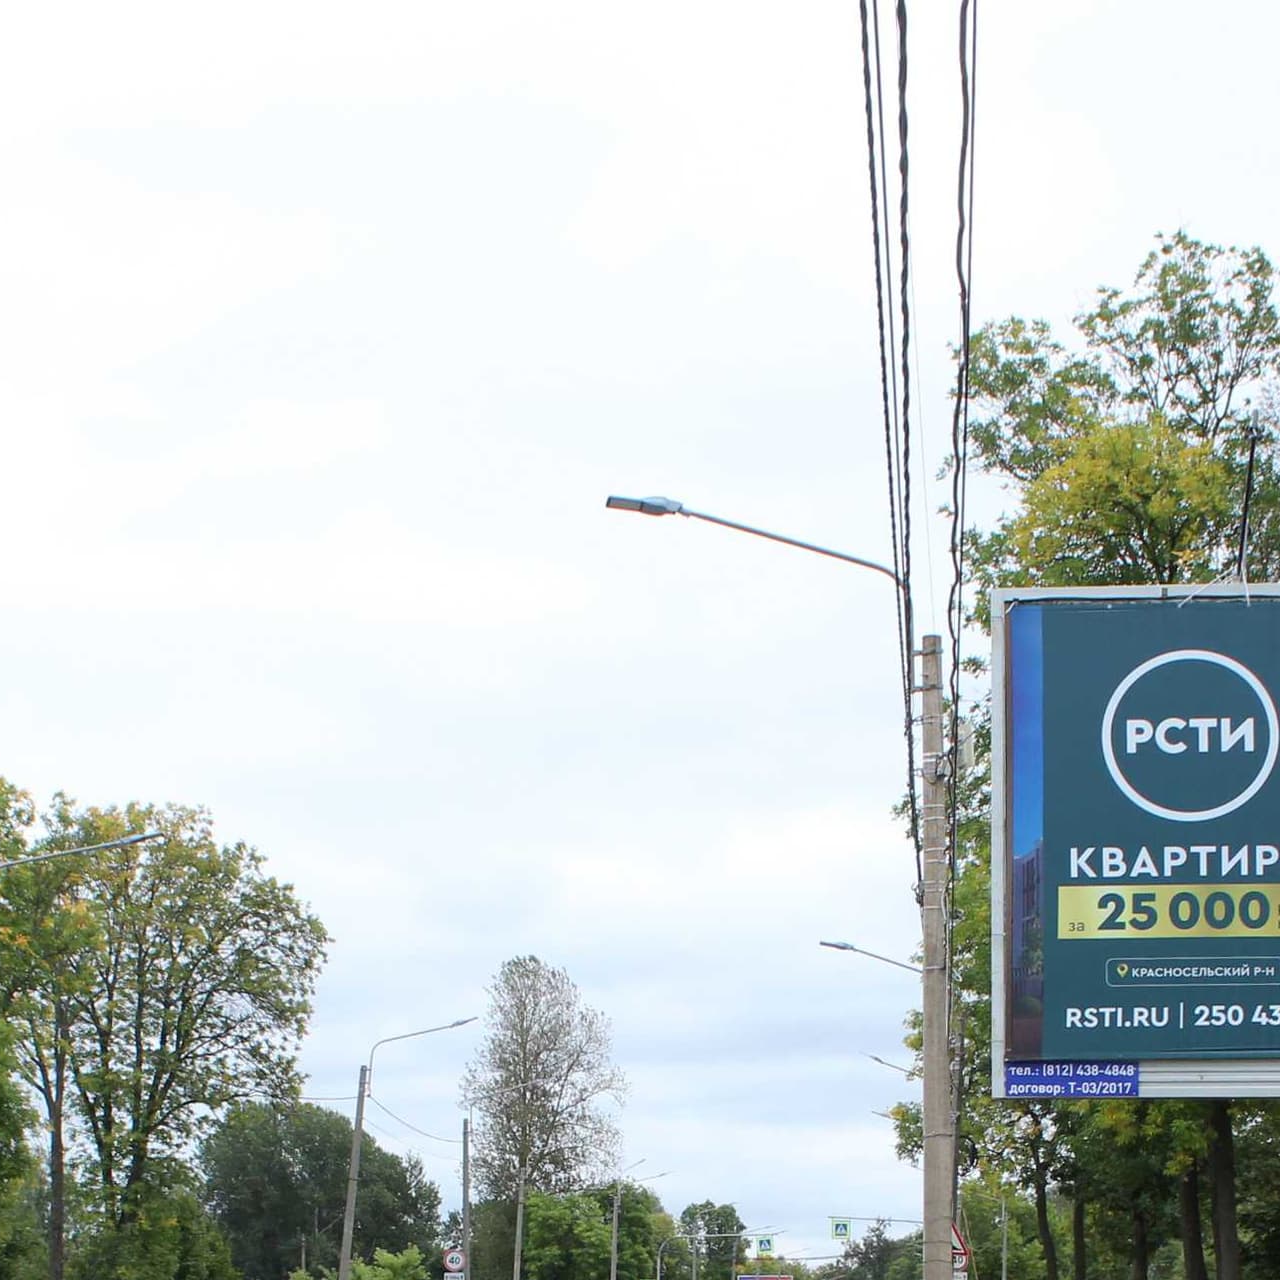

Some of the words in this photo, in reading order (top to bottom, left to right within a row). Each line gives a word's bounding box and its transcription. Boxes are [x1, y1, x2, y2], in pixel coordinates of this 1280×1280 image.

[1125, 717, 1254, 754] РСТИ
[1068, 922, 1085, 932] за
[1097, 892, 1158, 931] 25
[1169, 891, 1270, 930] 000
[1131, 964, 1250, 978] КРАСНОСЕЛЬСКИЙ
[1254, 966, 1275, 977] Р-Н
[1066, 1006, 1169, 1028] RSTI.RU
[1194, 1005, 1243, 1026] 250
[1008, 1066, 1039, 1076] тел.:
[1042, 1064, 1073, 1076] (812)
[1076, 1064, 1135, 1076] 438-4848
[1008, 1084, 1065, 1096] договор:
[1068, 1082, 1131, 1094] Т-03/2017
[449, 1256, 460, 1265] 40
